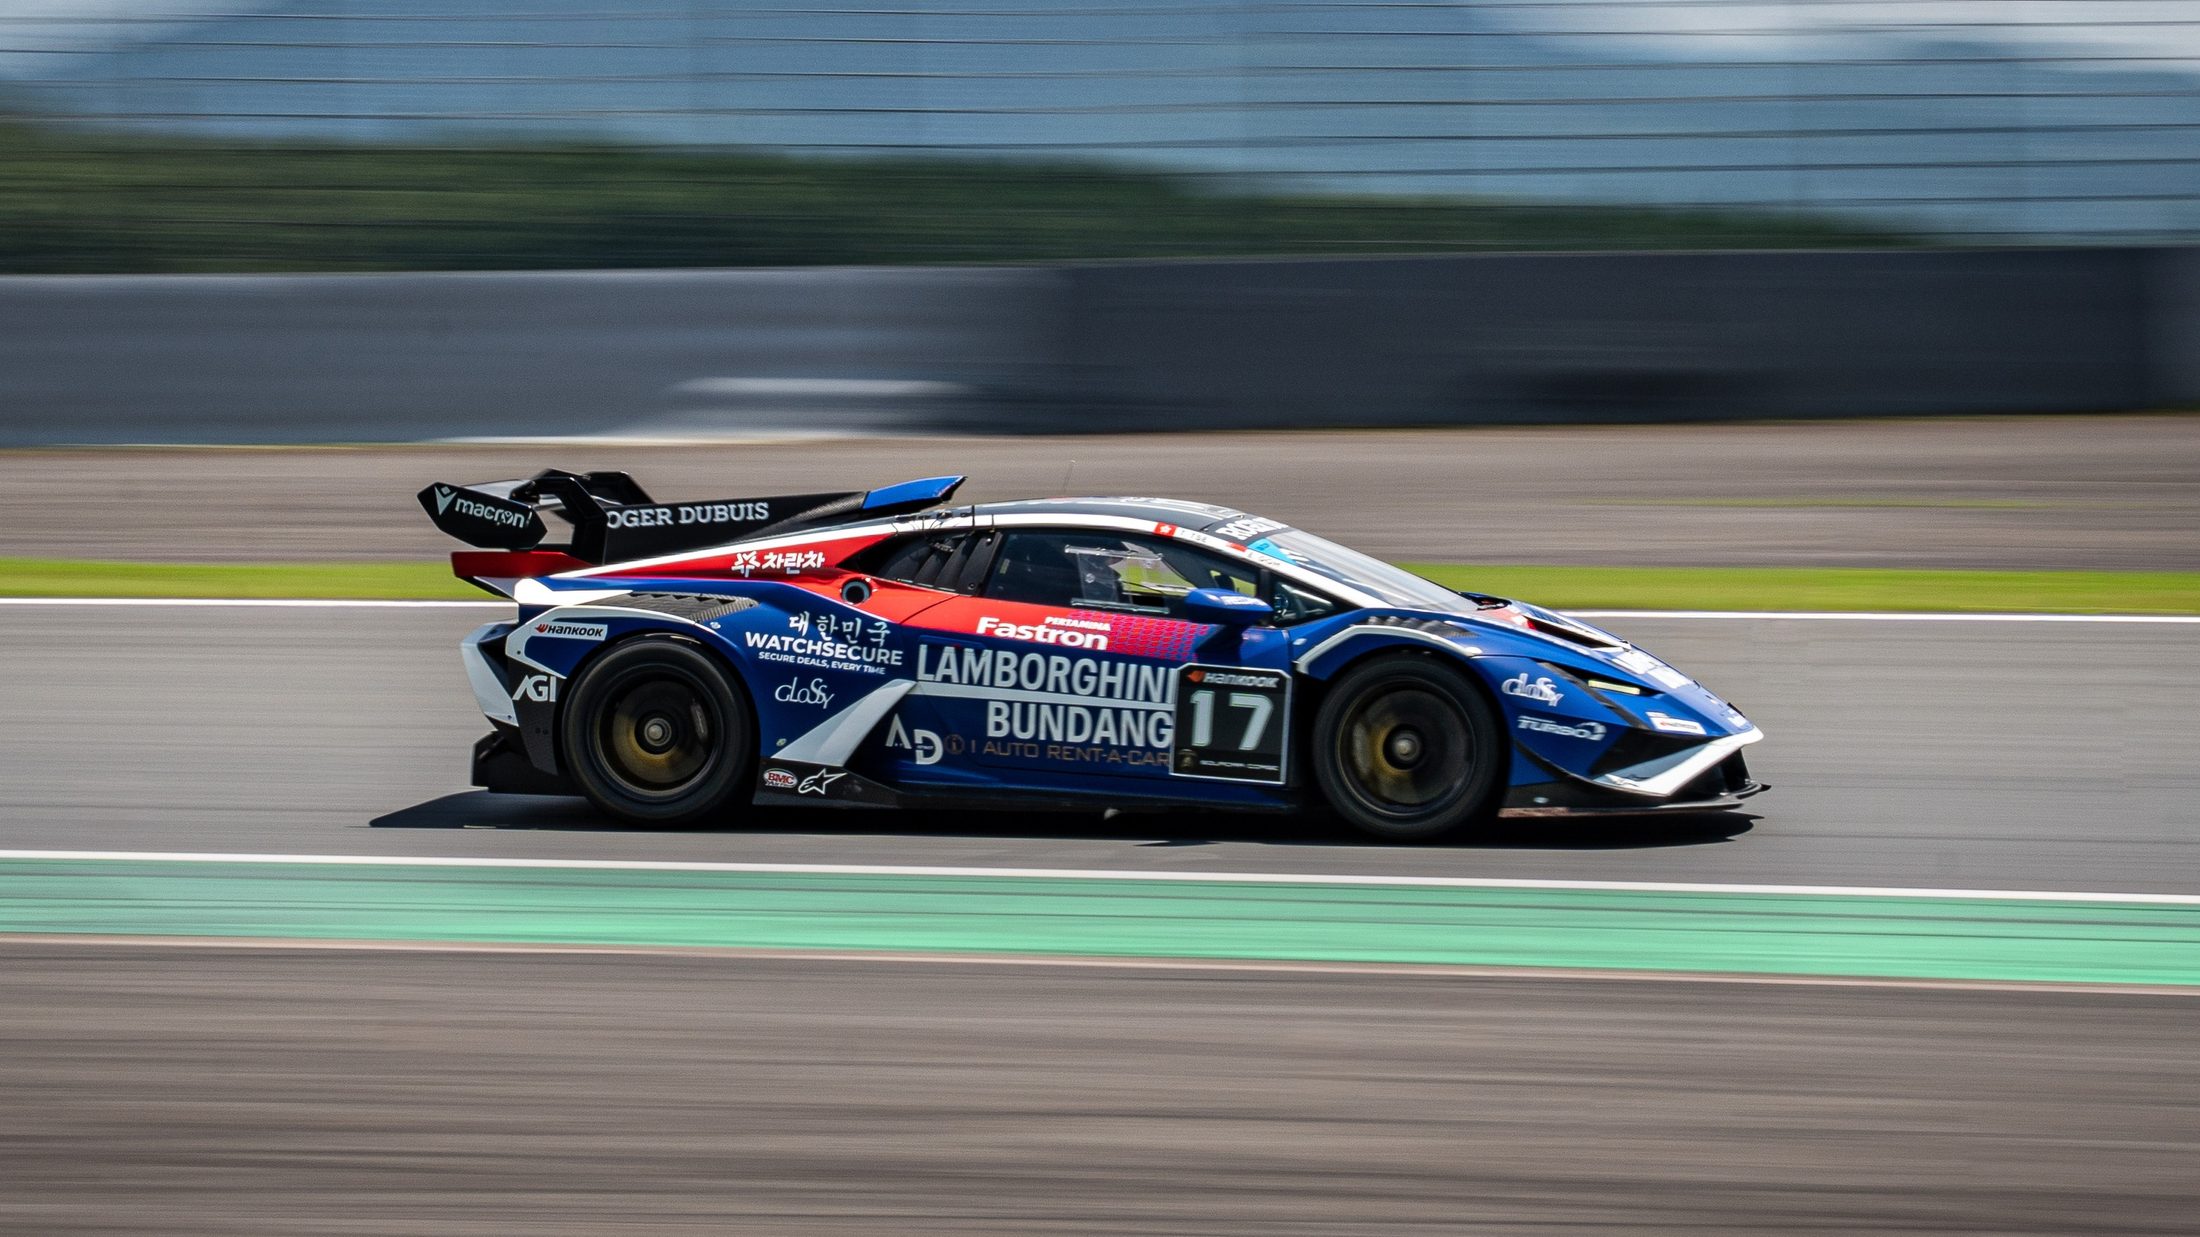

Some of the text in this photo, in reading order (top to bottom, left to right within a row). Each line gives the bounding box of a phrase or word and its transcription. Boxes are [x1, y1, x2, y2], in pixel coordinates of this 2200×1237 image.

[455, 498, 525, 528] macron
[607, 502, 770, 529] OGER DUBUIS
[761, 550, 826, 574] 차란차
[789, 610, 891, 647] 대한민국
[976, 616, 1109, 650] Fastron
[1044, 616, 1111, 631] PERTAMINA
[745, 631, 904, 666] WATCHSECURE
[758, 651, 886, 675] SECURE DEALS, EVERY TIME
[512, 674, 557, 702] AGI
[917, 644, 1179, 703] LAMBORGHINI
[986, 701, 1175, 748] BUNDANG
[1190, 690, 1274, 751] 17
[983, 740, 1040, 758] AUTO
[768, 772, 795, 785] BMC
